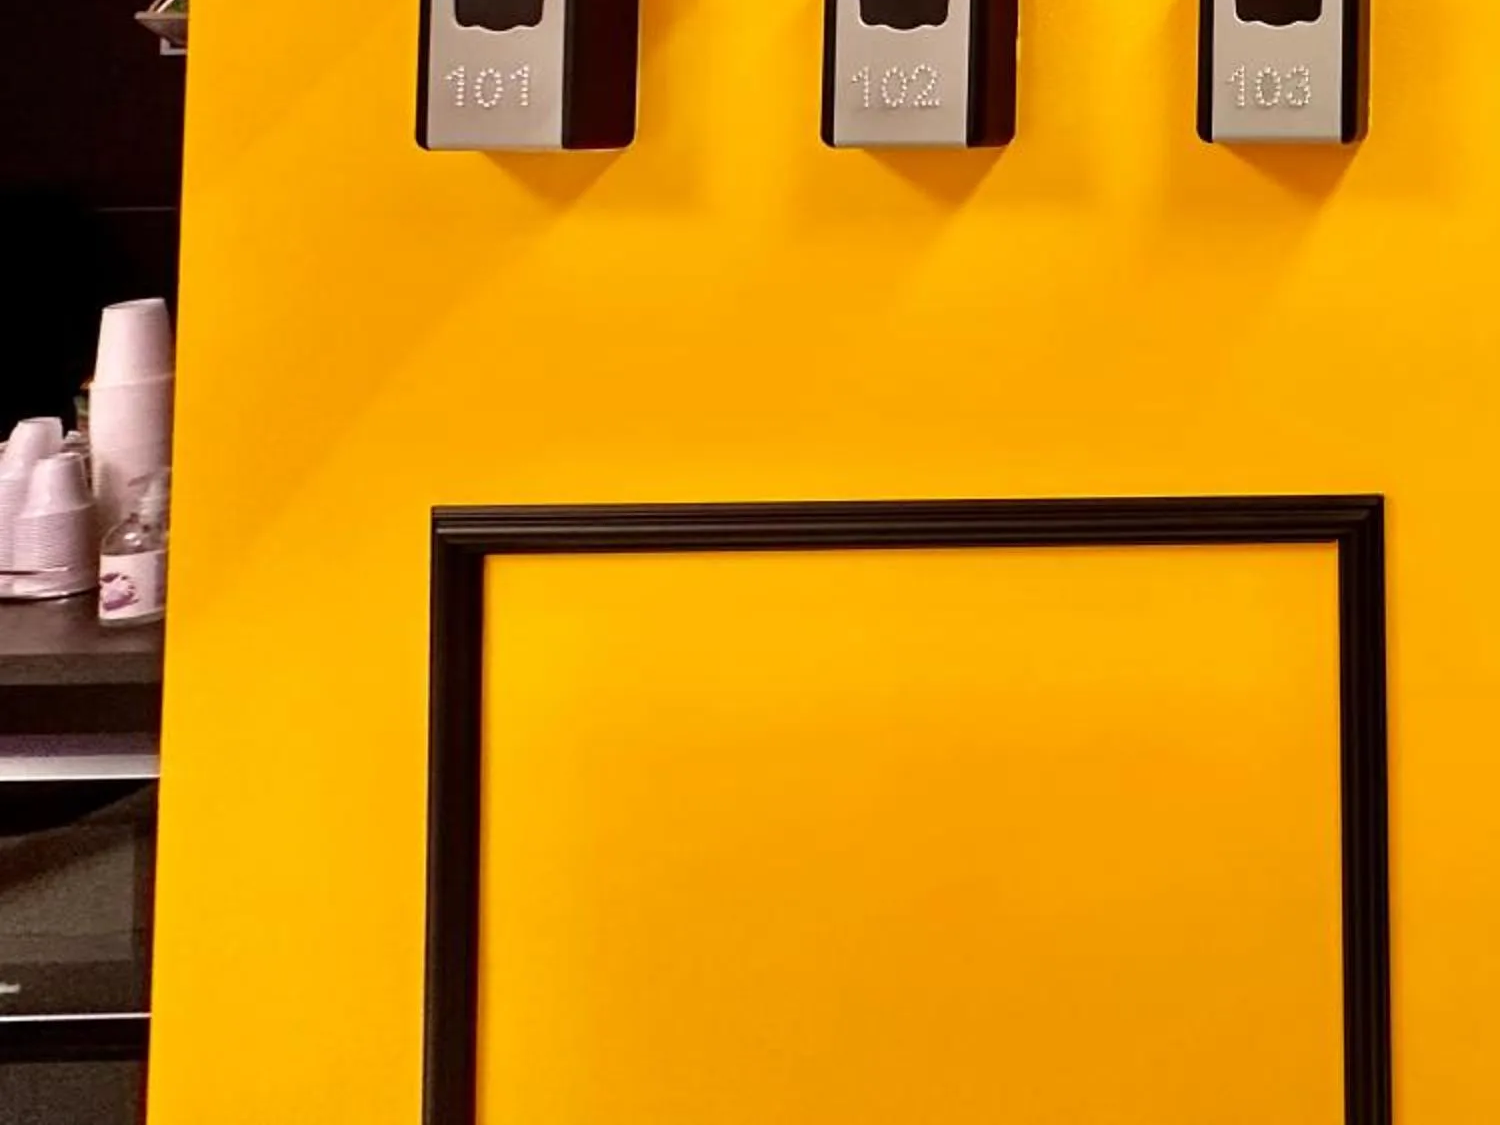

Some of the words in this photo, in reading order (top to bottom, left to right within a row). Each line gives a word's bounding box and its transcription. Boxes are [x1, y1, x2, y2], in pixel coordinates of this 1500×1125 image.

[445, 64, 530, 109] 101
[851, 64, 941, 109] 102
[1228, 64, 1312, 109] 103
